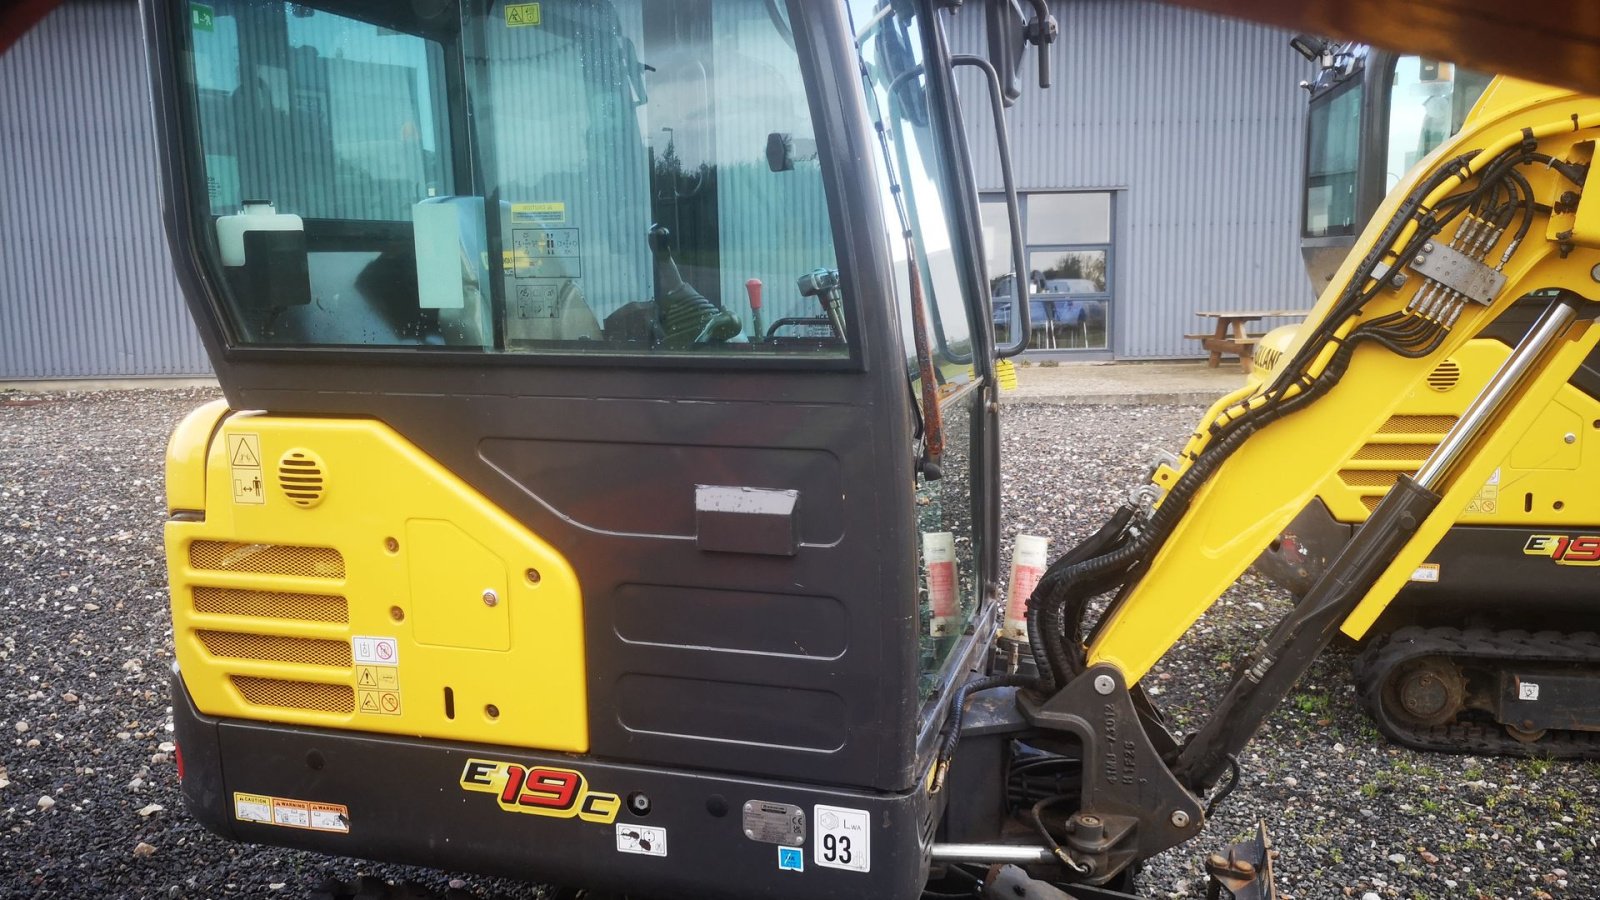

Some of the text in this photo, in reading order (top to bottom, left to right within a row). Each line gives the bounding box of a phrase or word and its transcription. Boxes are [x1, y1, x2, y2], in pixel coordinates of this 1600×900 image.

[244, 796, 267, 804] CAUTION
[281, 801, 305, 809] WARNING
[823, 833, 852, 864] 93
